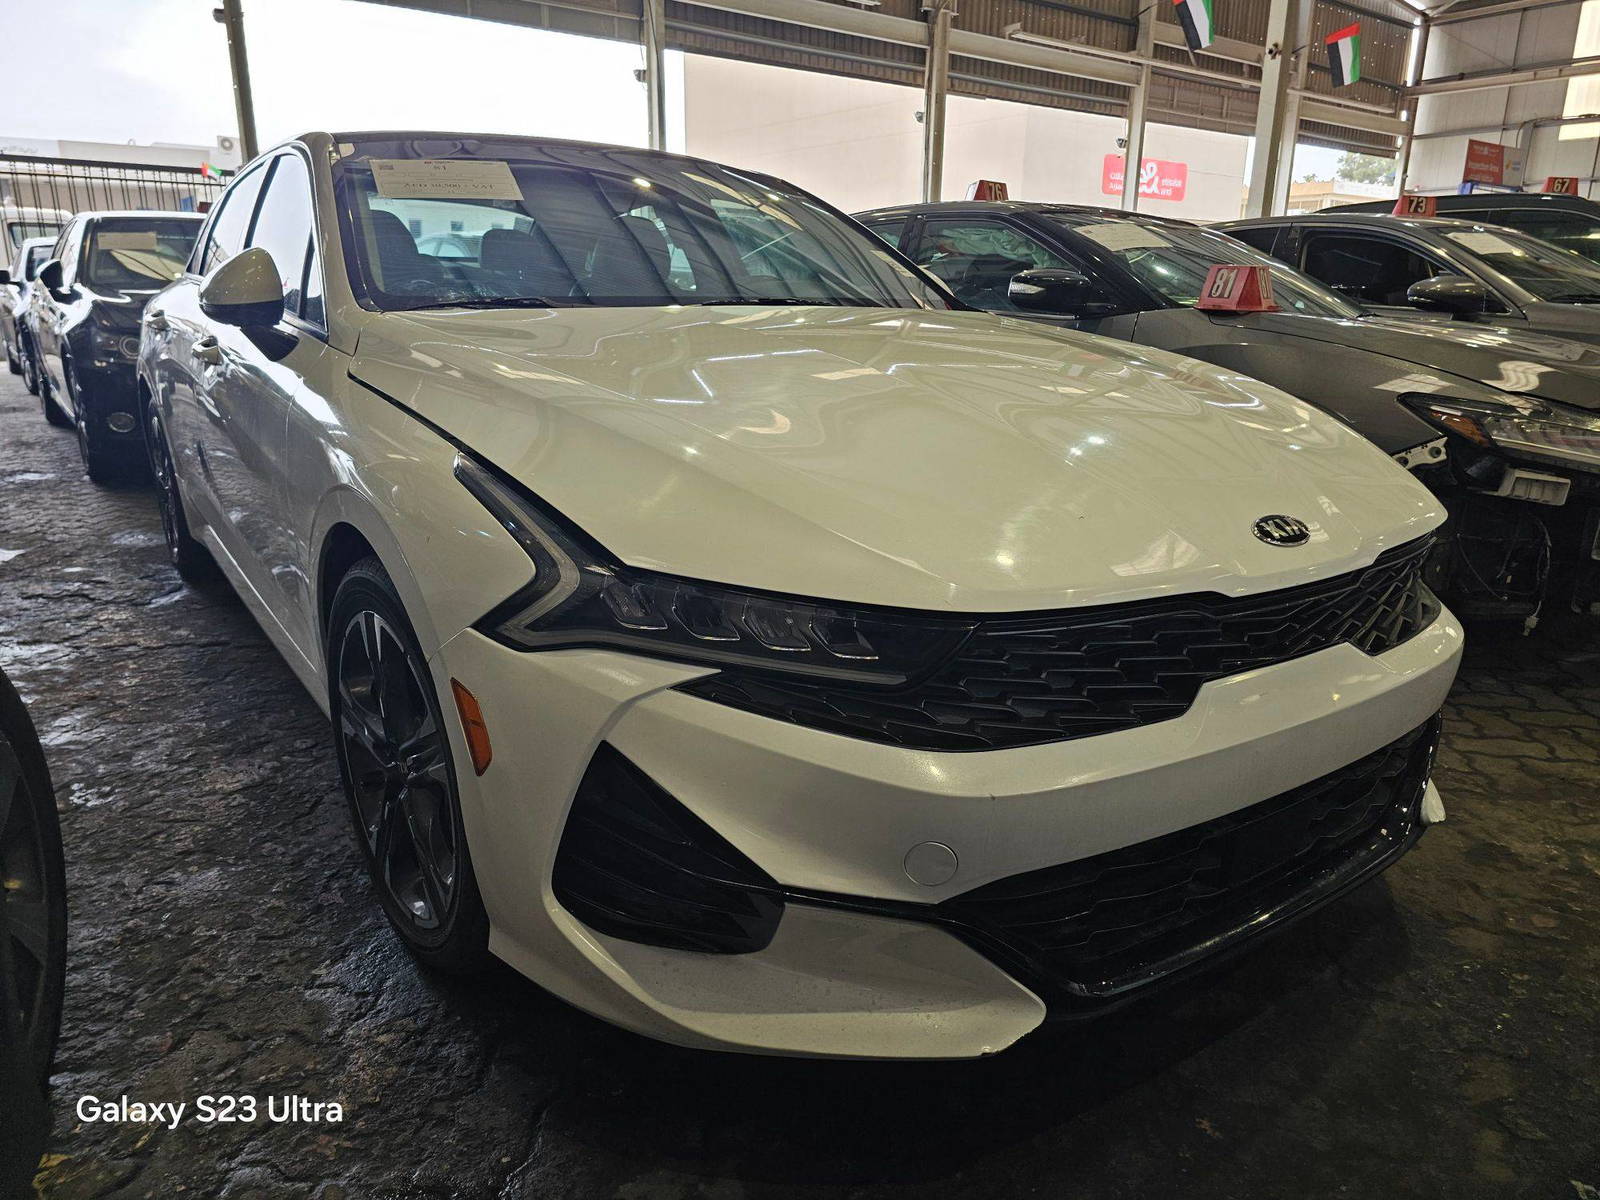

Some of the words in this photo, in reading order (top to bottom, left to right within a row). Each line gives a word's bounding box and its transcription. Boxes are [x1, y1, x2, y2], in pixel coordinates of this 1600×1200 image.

[988, 183, 1003, 200] 76
[1553, 179, 1571, 193] 67
[1408, 197, 1426, 213] 73
[1211, 269, 1238, 298] 81
[1259, 518, 1301, 539] KIA
